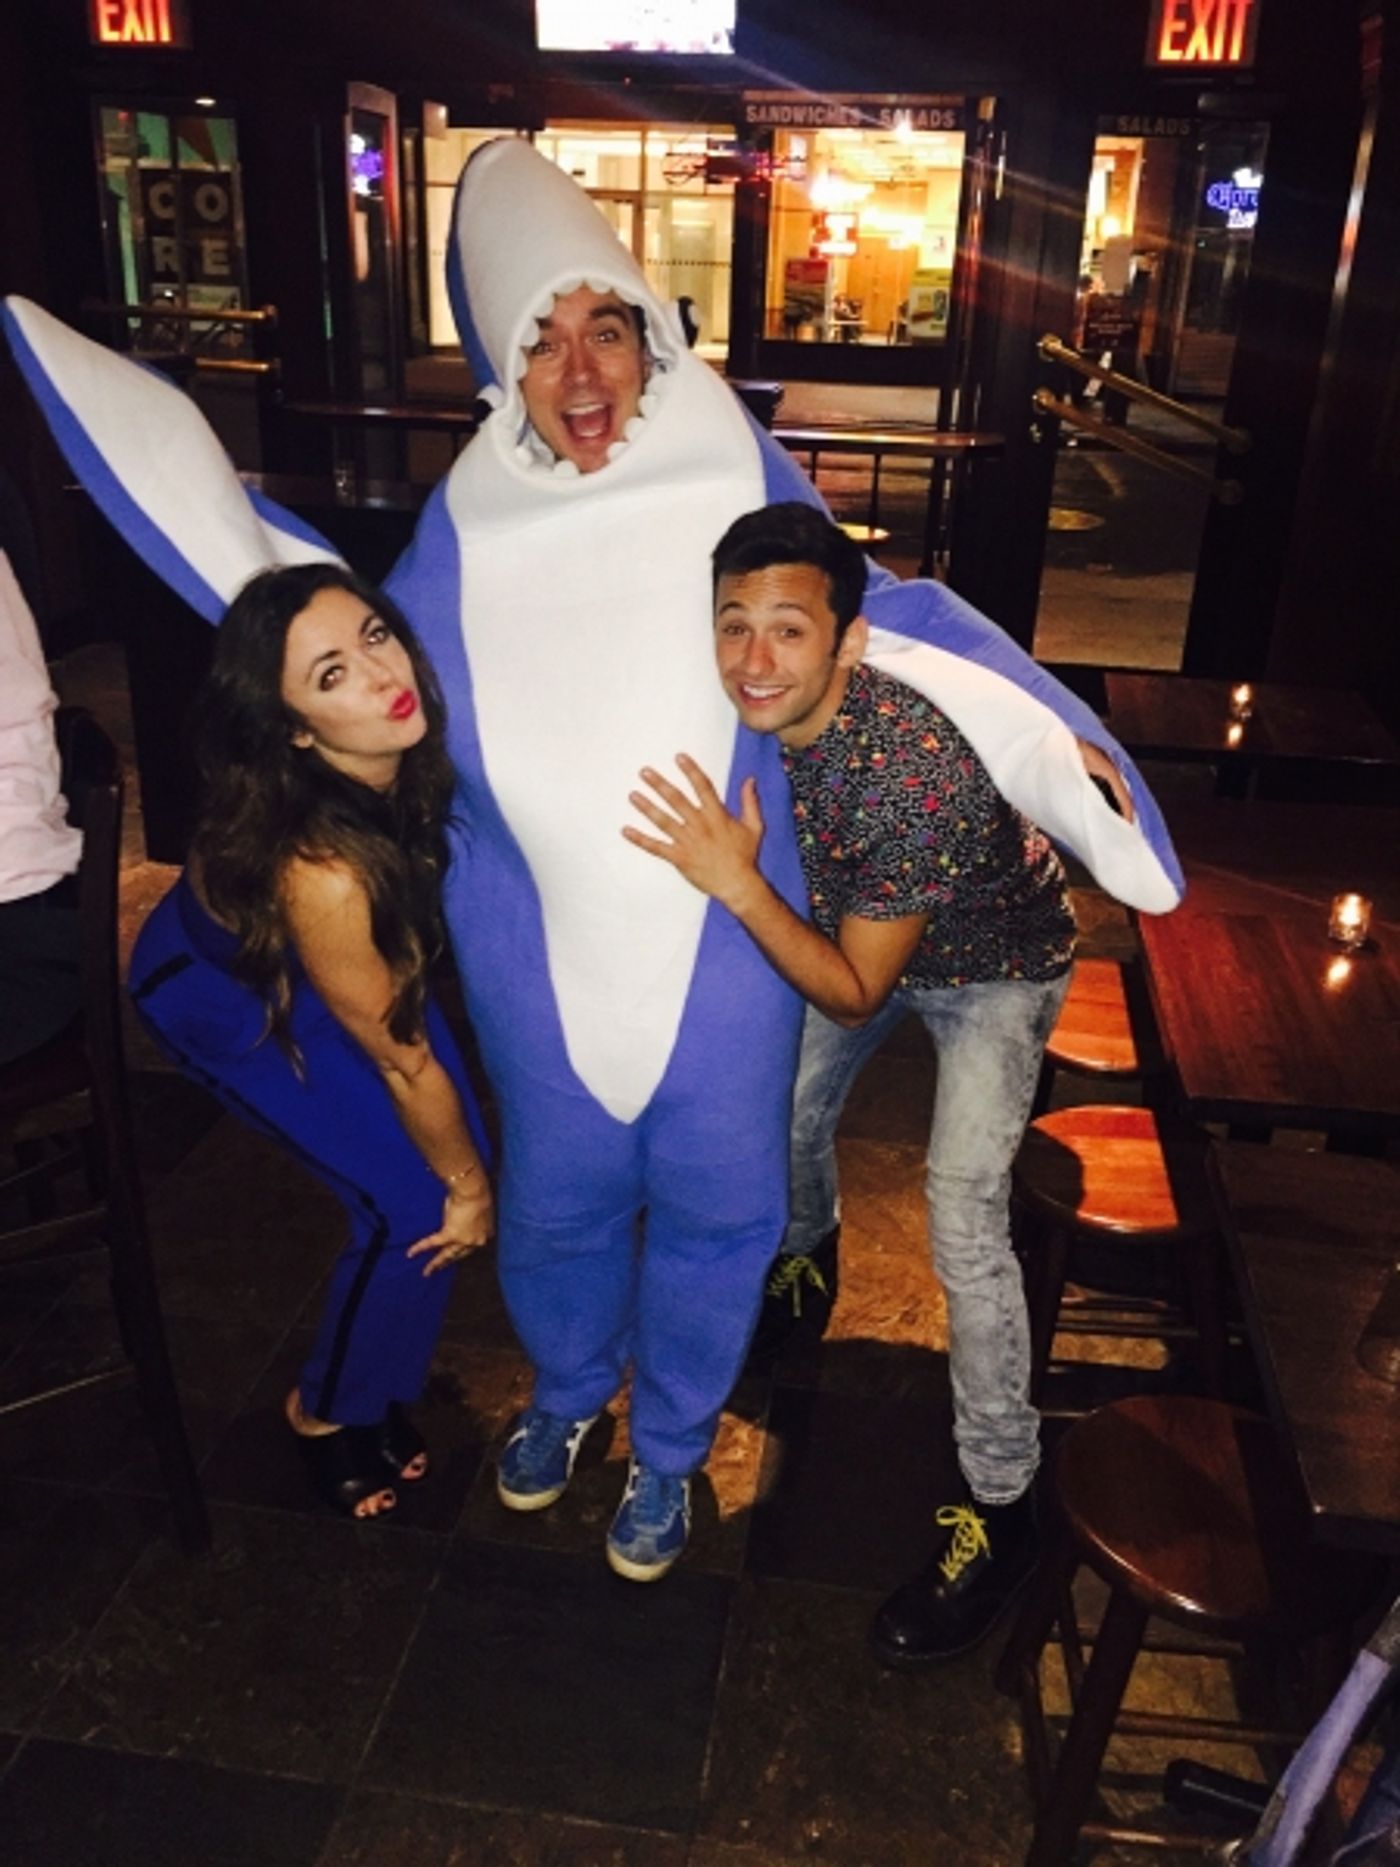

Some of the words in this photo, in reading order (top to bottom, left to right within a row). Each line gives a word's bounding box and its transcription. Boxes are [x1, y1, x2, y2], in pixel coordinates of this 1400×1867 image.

[1158, 0, 1252, 61] EXIT
[746, 105, 861, 127] SANDWICHES
[880, 108, 955, 129] SALADS
[1117, 115, 1190, 136] SALADS
